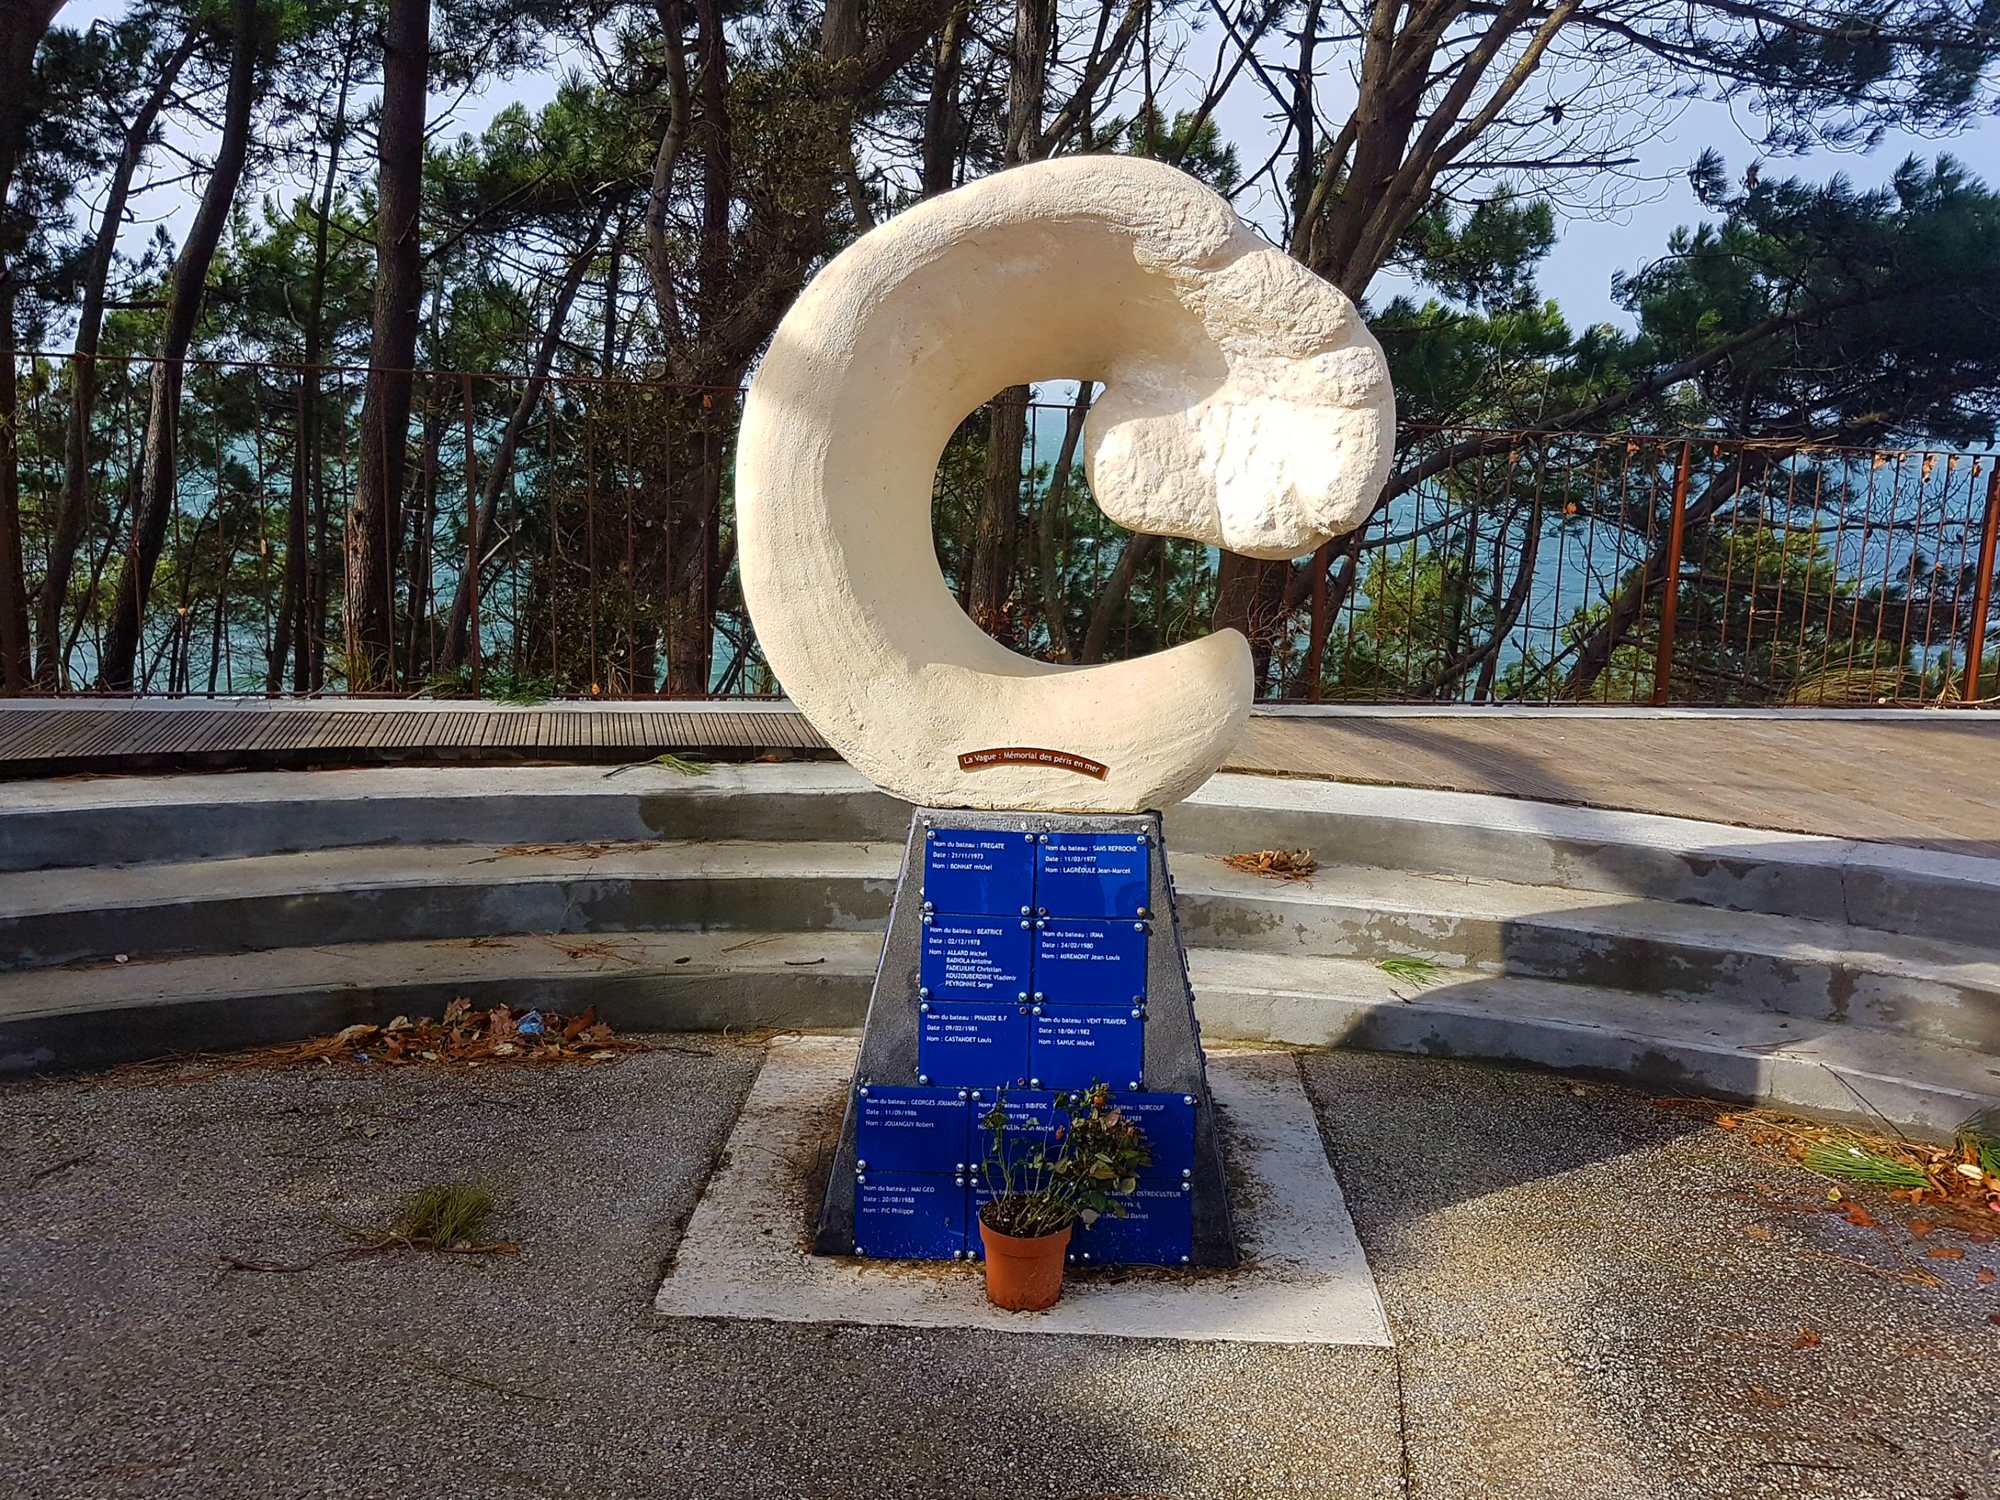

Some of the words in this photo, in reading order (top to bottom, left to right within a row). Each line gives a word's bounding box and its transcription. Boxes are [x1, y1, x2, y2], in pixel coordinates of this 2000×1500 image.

[976, 753, 996, 766] Vague
[1003, 751, 1037, 760] Mémorial
[1039, 753, 1052, 762] des
[1054, 753, 1072, 765] péris
[1085, 763, 1100, 773] mer
